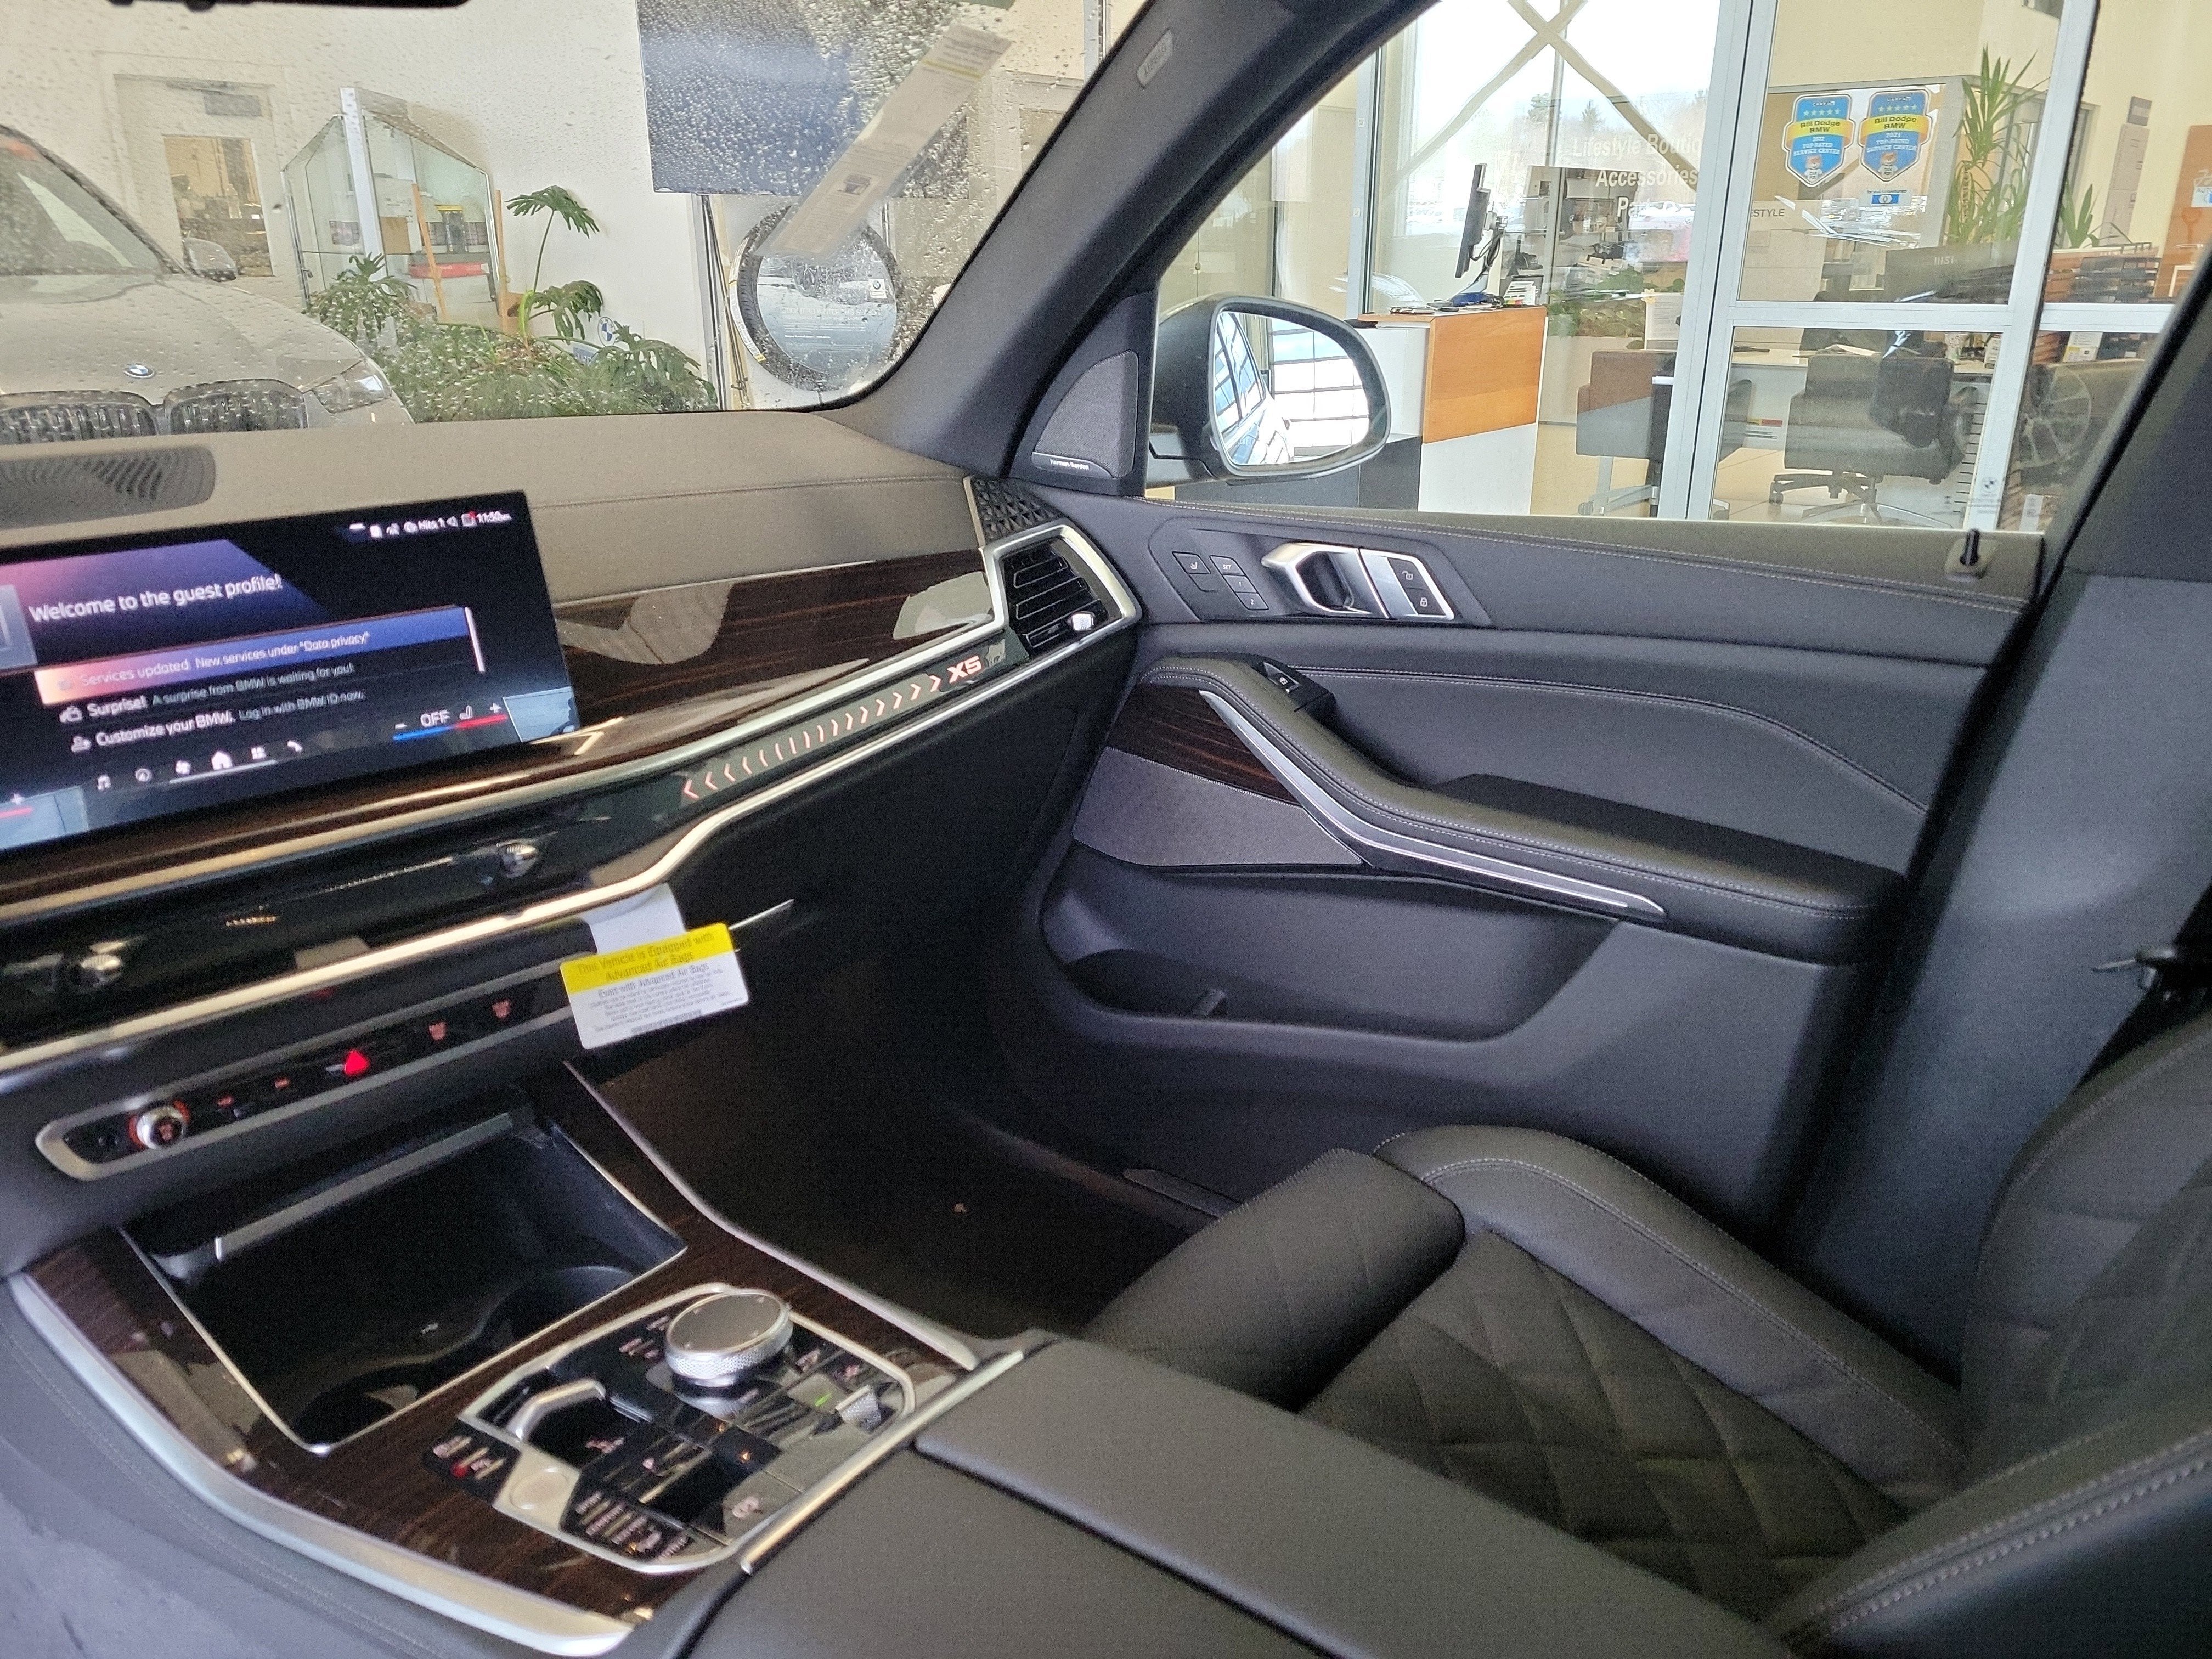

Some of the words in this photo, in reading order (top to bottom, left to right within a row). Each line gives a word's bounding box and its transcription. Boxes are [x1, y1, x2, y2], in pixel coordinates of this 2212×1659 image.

[1573, 136, 1641, 160] Lifestyle
[1595, 165, 1698, 187] Accessories
[29, 597, 115, 622] Welcome
[119, 594, 138, 610] to
[140, 590, 170, 607] the
[173, 583, 224, 607] guest
[225, 573, 283, 599] profile!
[80, 669, 134, 686] Services
[195, 656, 221, 669] New
[223, 650, 266, 665] services
[268, 644, 299, 657] under
[946, 655, 982, 684] X5
[87, 694, 148, 718] Surprise!
[152, 694, 163, 706] A
[163, 689, 208, 704] surprise
[208, 684, 234, 696] from
[235, 677, 264, 692] BMW
[267, 675, 276, 686] is
[278, 670, 317, 686] waiting
[317, 667, 330, 678] for
[95, 725, 165, 747] Customize
[166, 719, 195, 736] your
[239, 708, 261, 721] Log
[261, 706, 273, 716] in
[273, 701, 297, 714] with
[297, 695, 325, 710] BMW
[326, 692, 338, 705] ID
[420, 709, 450, 727] OFF
